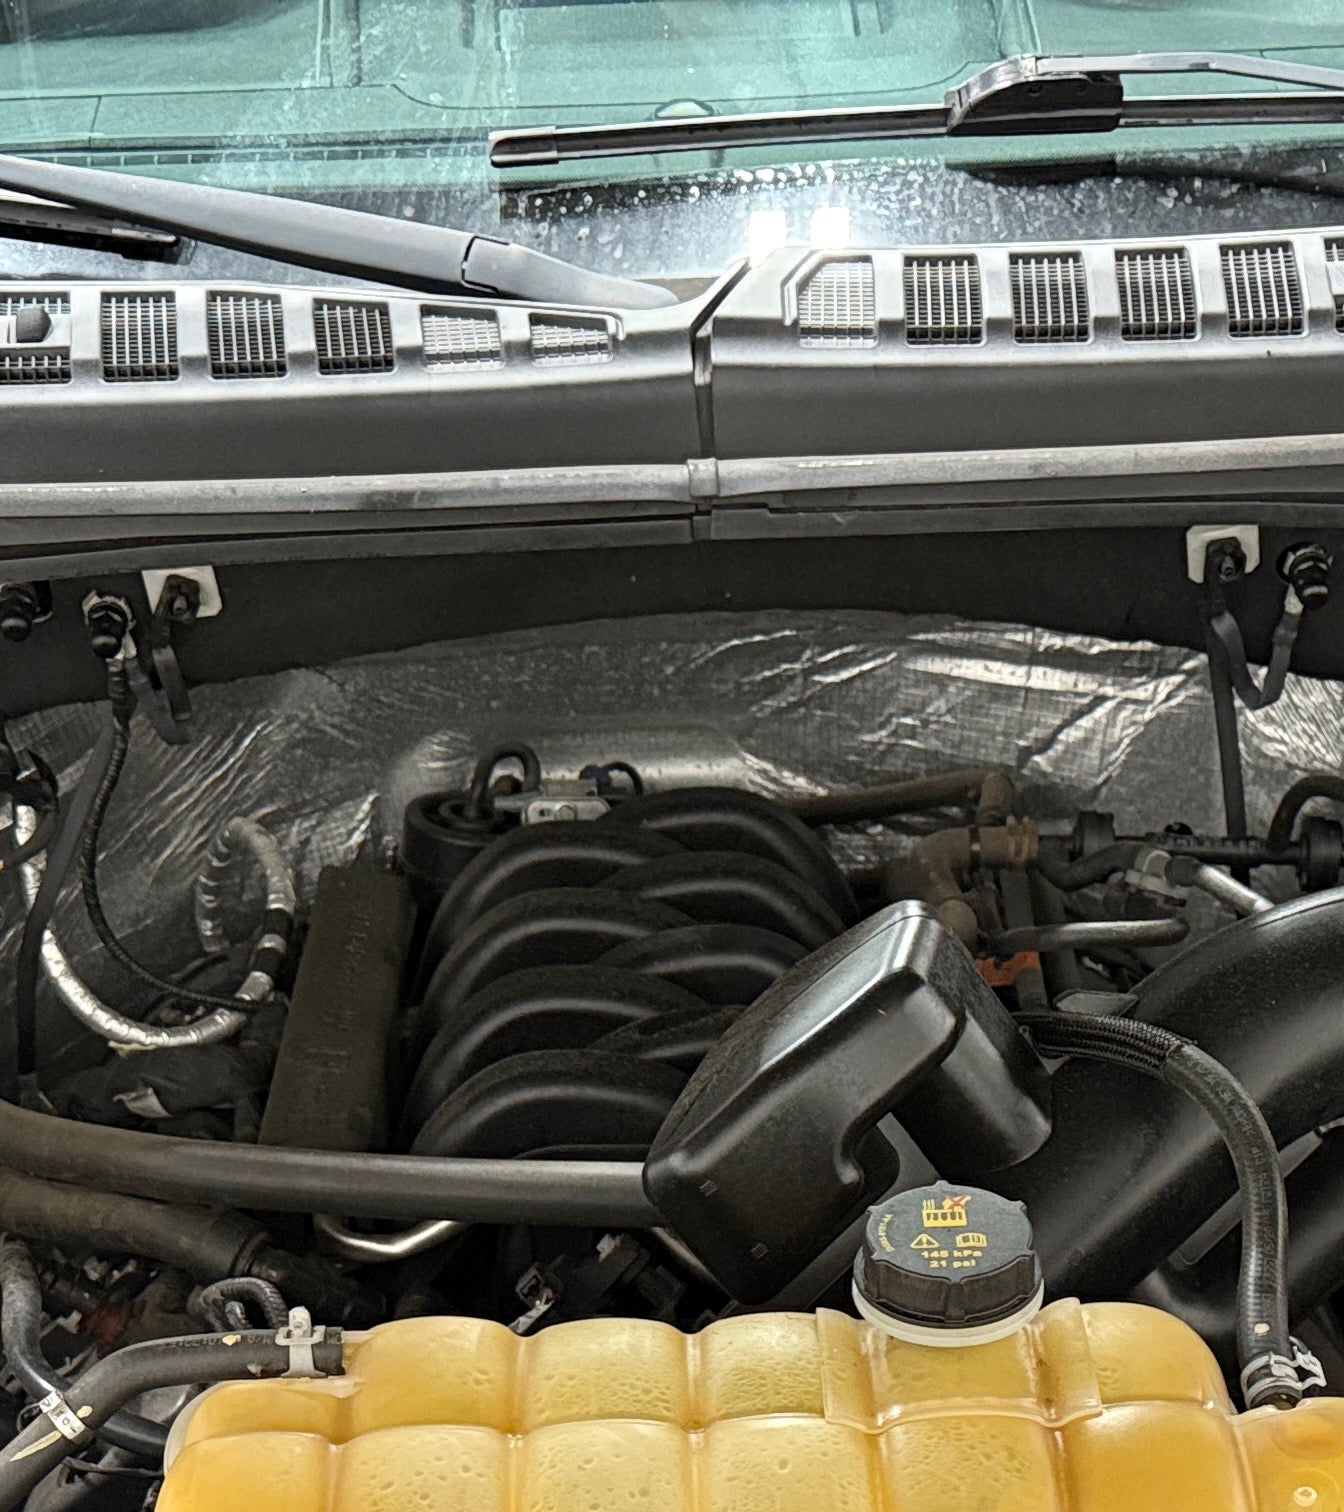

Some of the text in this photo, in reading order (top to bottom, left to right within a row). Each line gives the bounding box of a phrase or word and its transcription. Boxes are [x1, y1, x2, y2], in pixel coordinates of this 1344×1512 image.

[921, 1250, 983, 1258] 145 kPa
[929, 1260, 947, 1268] 21
